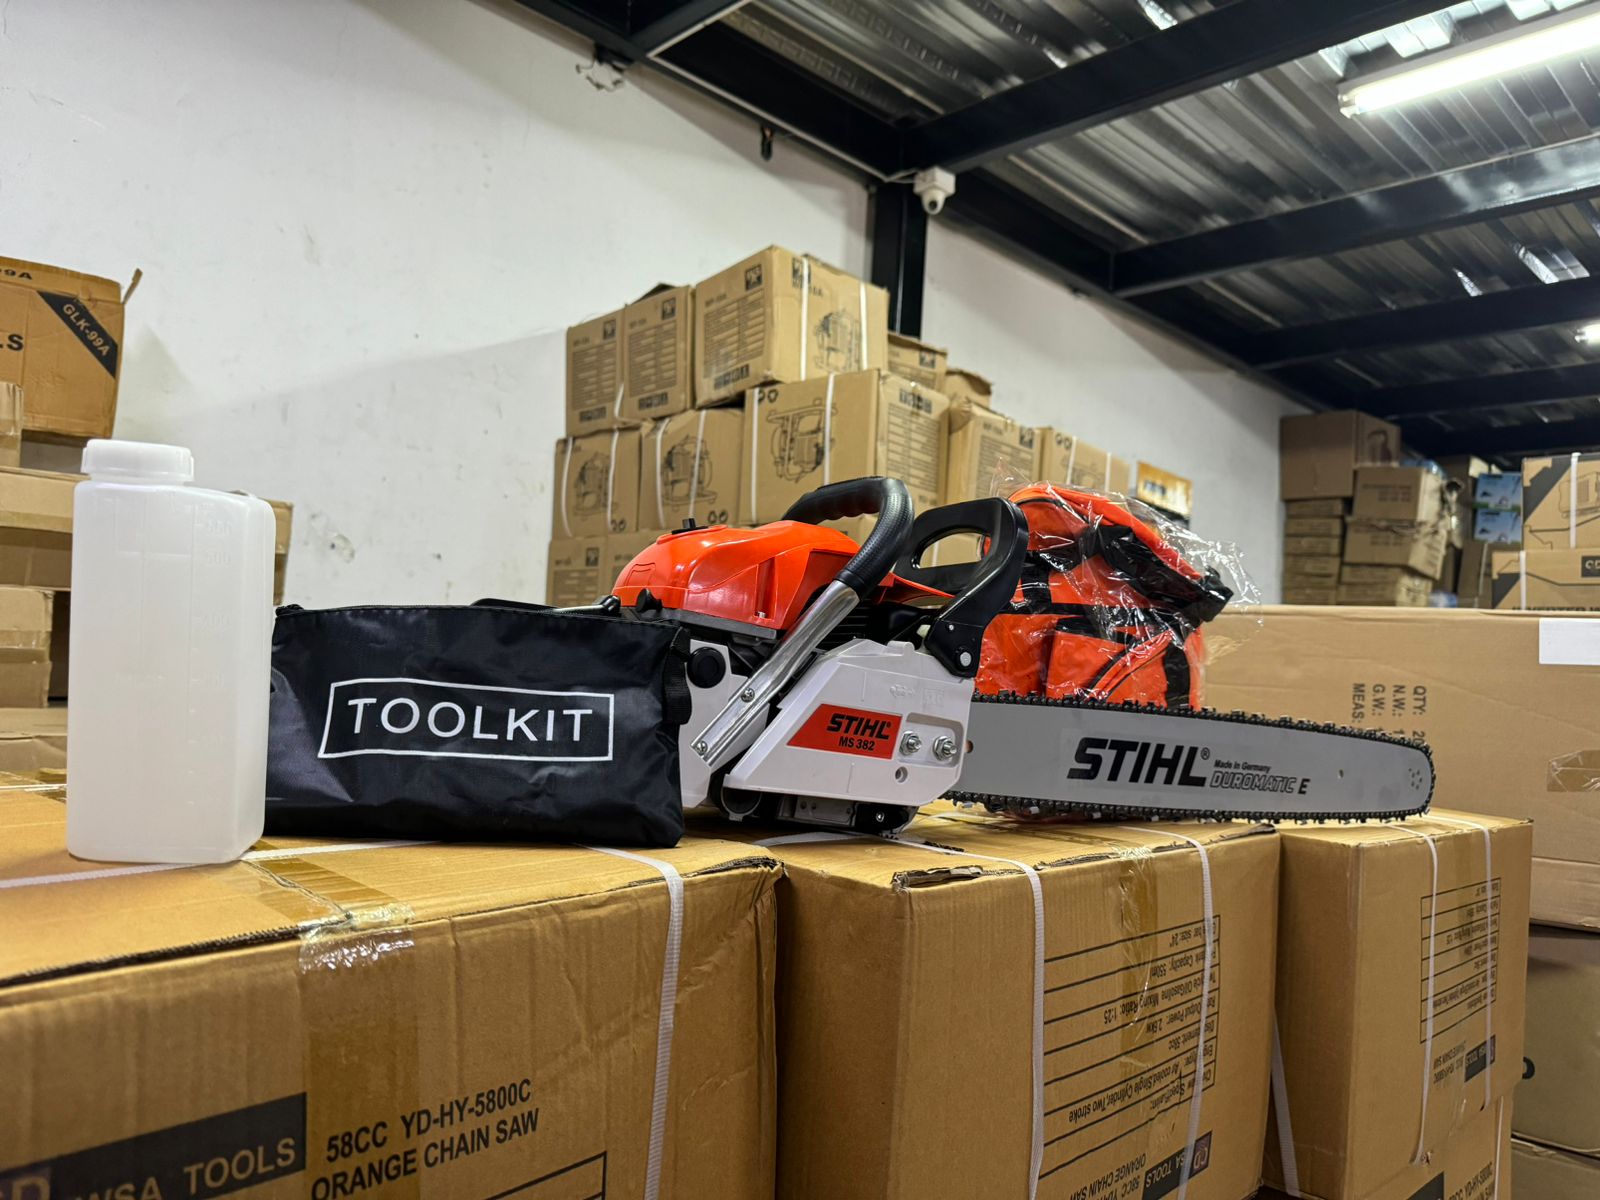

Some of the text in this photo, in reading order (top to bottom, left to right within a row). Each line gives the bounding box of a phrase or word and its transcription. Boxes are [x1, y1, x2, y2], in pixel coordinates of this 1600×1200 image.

[62, 303, 111, 356] GLK-99A
[1351, 682, 1366, 724] MEAS:
[1412, 685, 1428, 716] QTY:
[347, 697, 594, 742] TOOLKIT
[838, 735, 876, 752] MS 382
[1213, 758, 1233, 769] Made
[1241, 761, 1272, 774] Germany
[1209, 770, 1311, 795] DUROMATIC E
[1103, 1007, 1117, 1025] 1:25
[326, 1077, 532, 1164] 58CC YD-HY-5800C
[1068, 1103, 1092, 1124] stroke
[183, 1137, 297, 1195] TOOLS
[311, 1107, 540, 1200] ORANGE CHAIN SAW
[1114, 1152, 1147, 1184] ORANGE
[1088, 1172, 1114, 1197] CHAIN
[1145, 1159, 1172, 1188] TOOLS
